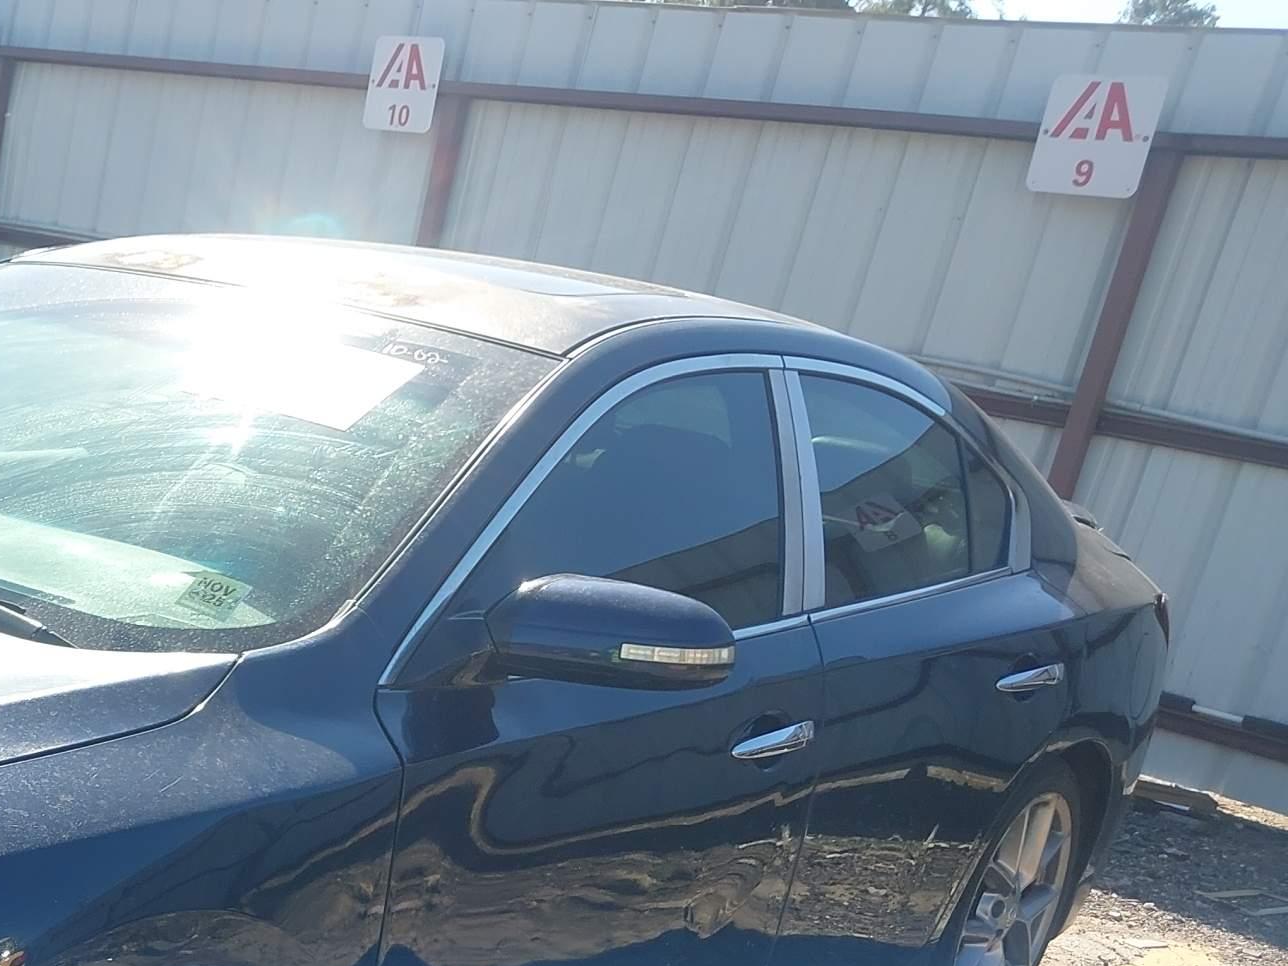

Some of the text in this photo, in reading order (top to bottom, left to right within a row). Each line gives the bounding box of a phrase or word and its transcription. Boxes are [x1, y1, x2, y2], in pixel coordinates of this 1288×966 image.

[388, 104, 410, 127] 10
[1072, 159, 1094, 187] 9
[198, 577, 236, 597] NOV
